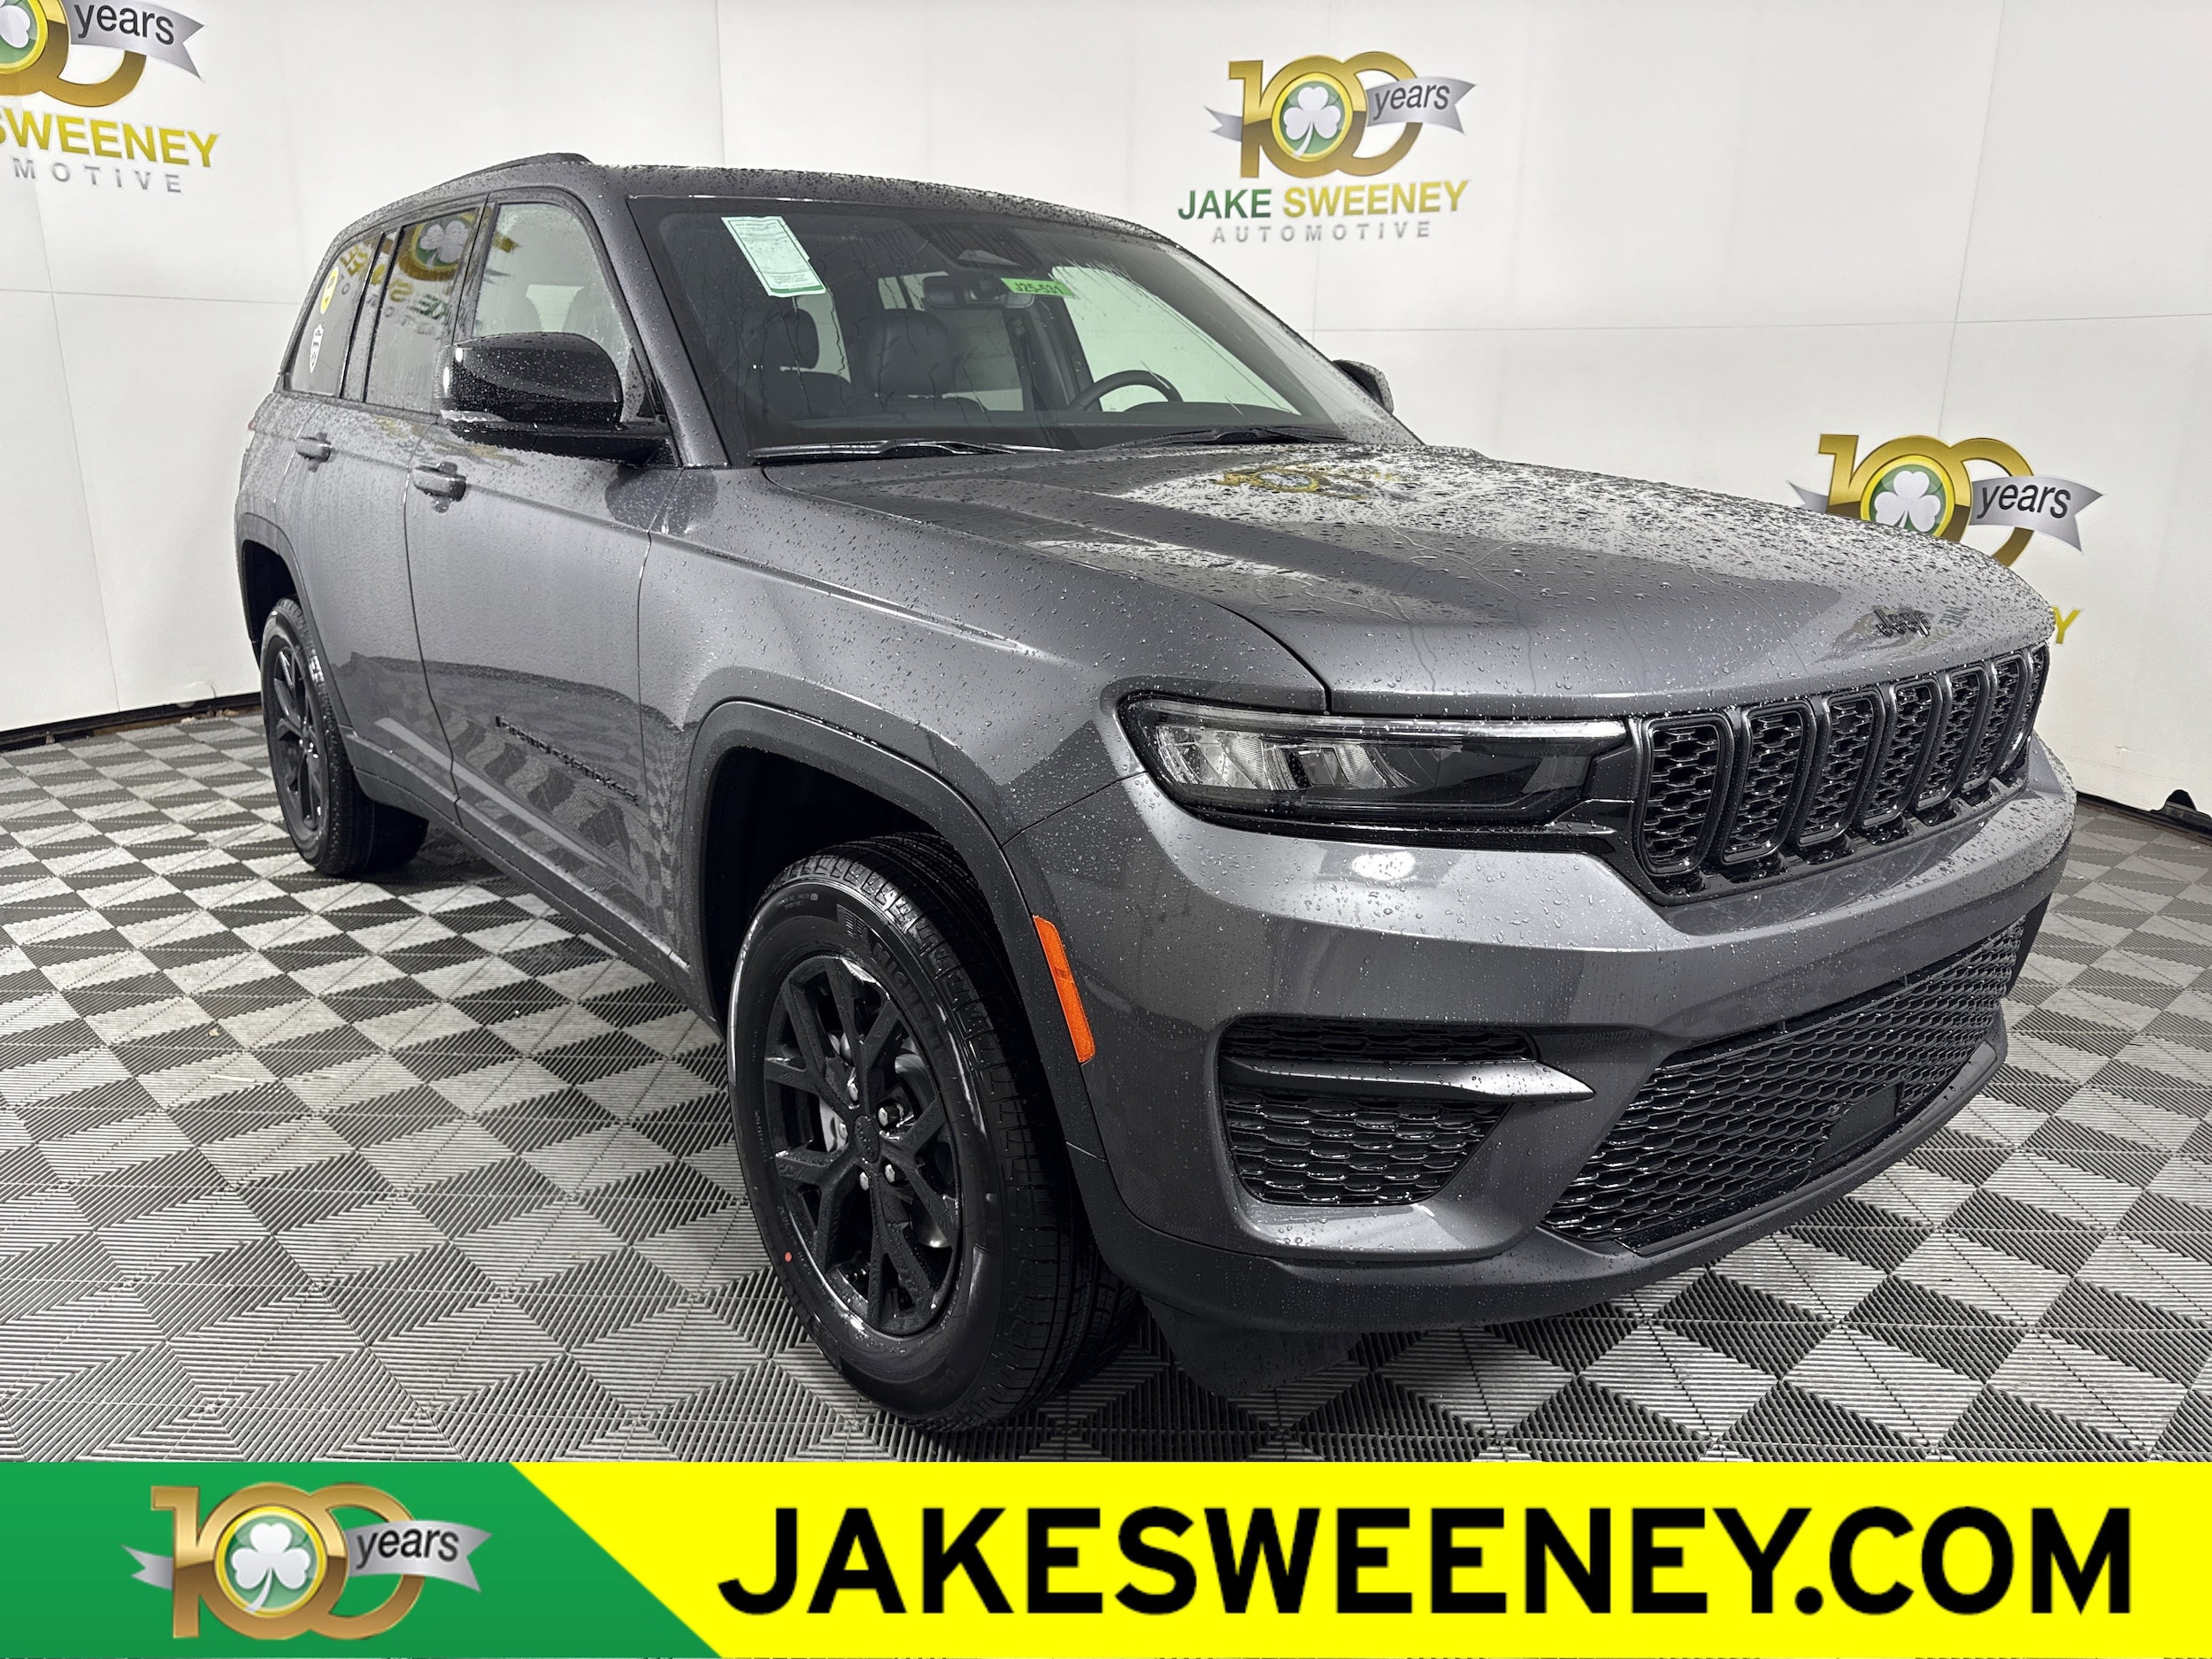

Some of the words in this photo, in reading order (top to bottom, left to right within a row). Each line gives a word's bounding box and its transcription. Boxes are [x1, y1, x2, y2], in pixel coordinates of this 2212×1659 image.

[73, 3, 174, 45] years
[1372, 82, 1451, 120] years
[0, 107, 219, 168] WEENEY
[1178, 188, 1272, 220] JAKE
[1283, 180, 1470, 219] SWEENEY
[1211, 221, 1431, 243] AUTOMOTIVE
[1014, 281, 1064, 295] J25-531
[1977, 483, 2071, 519] years
